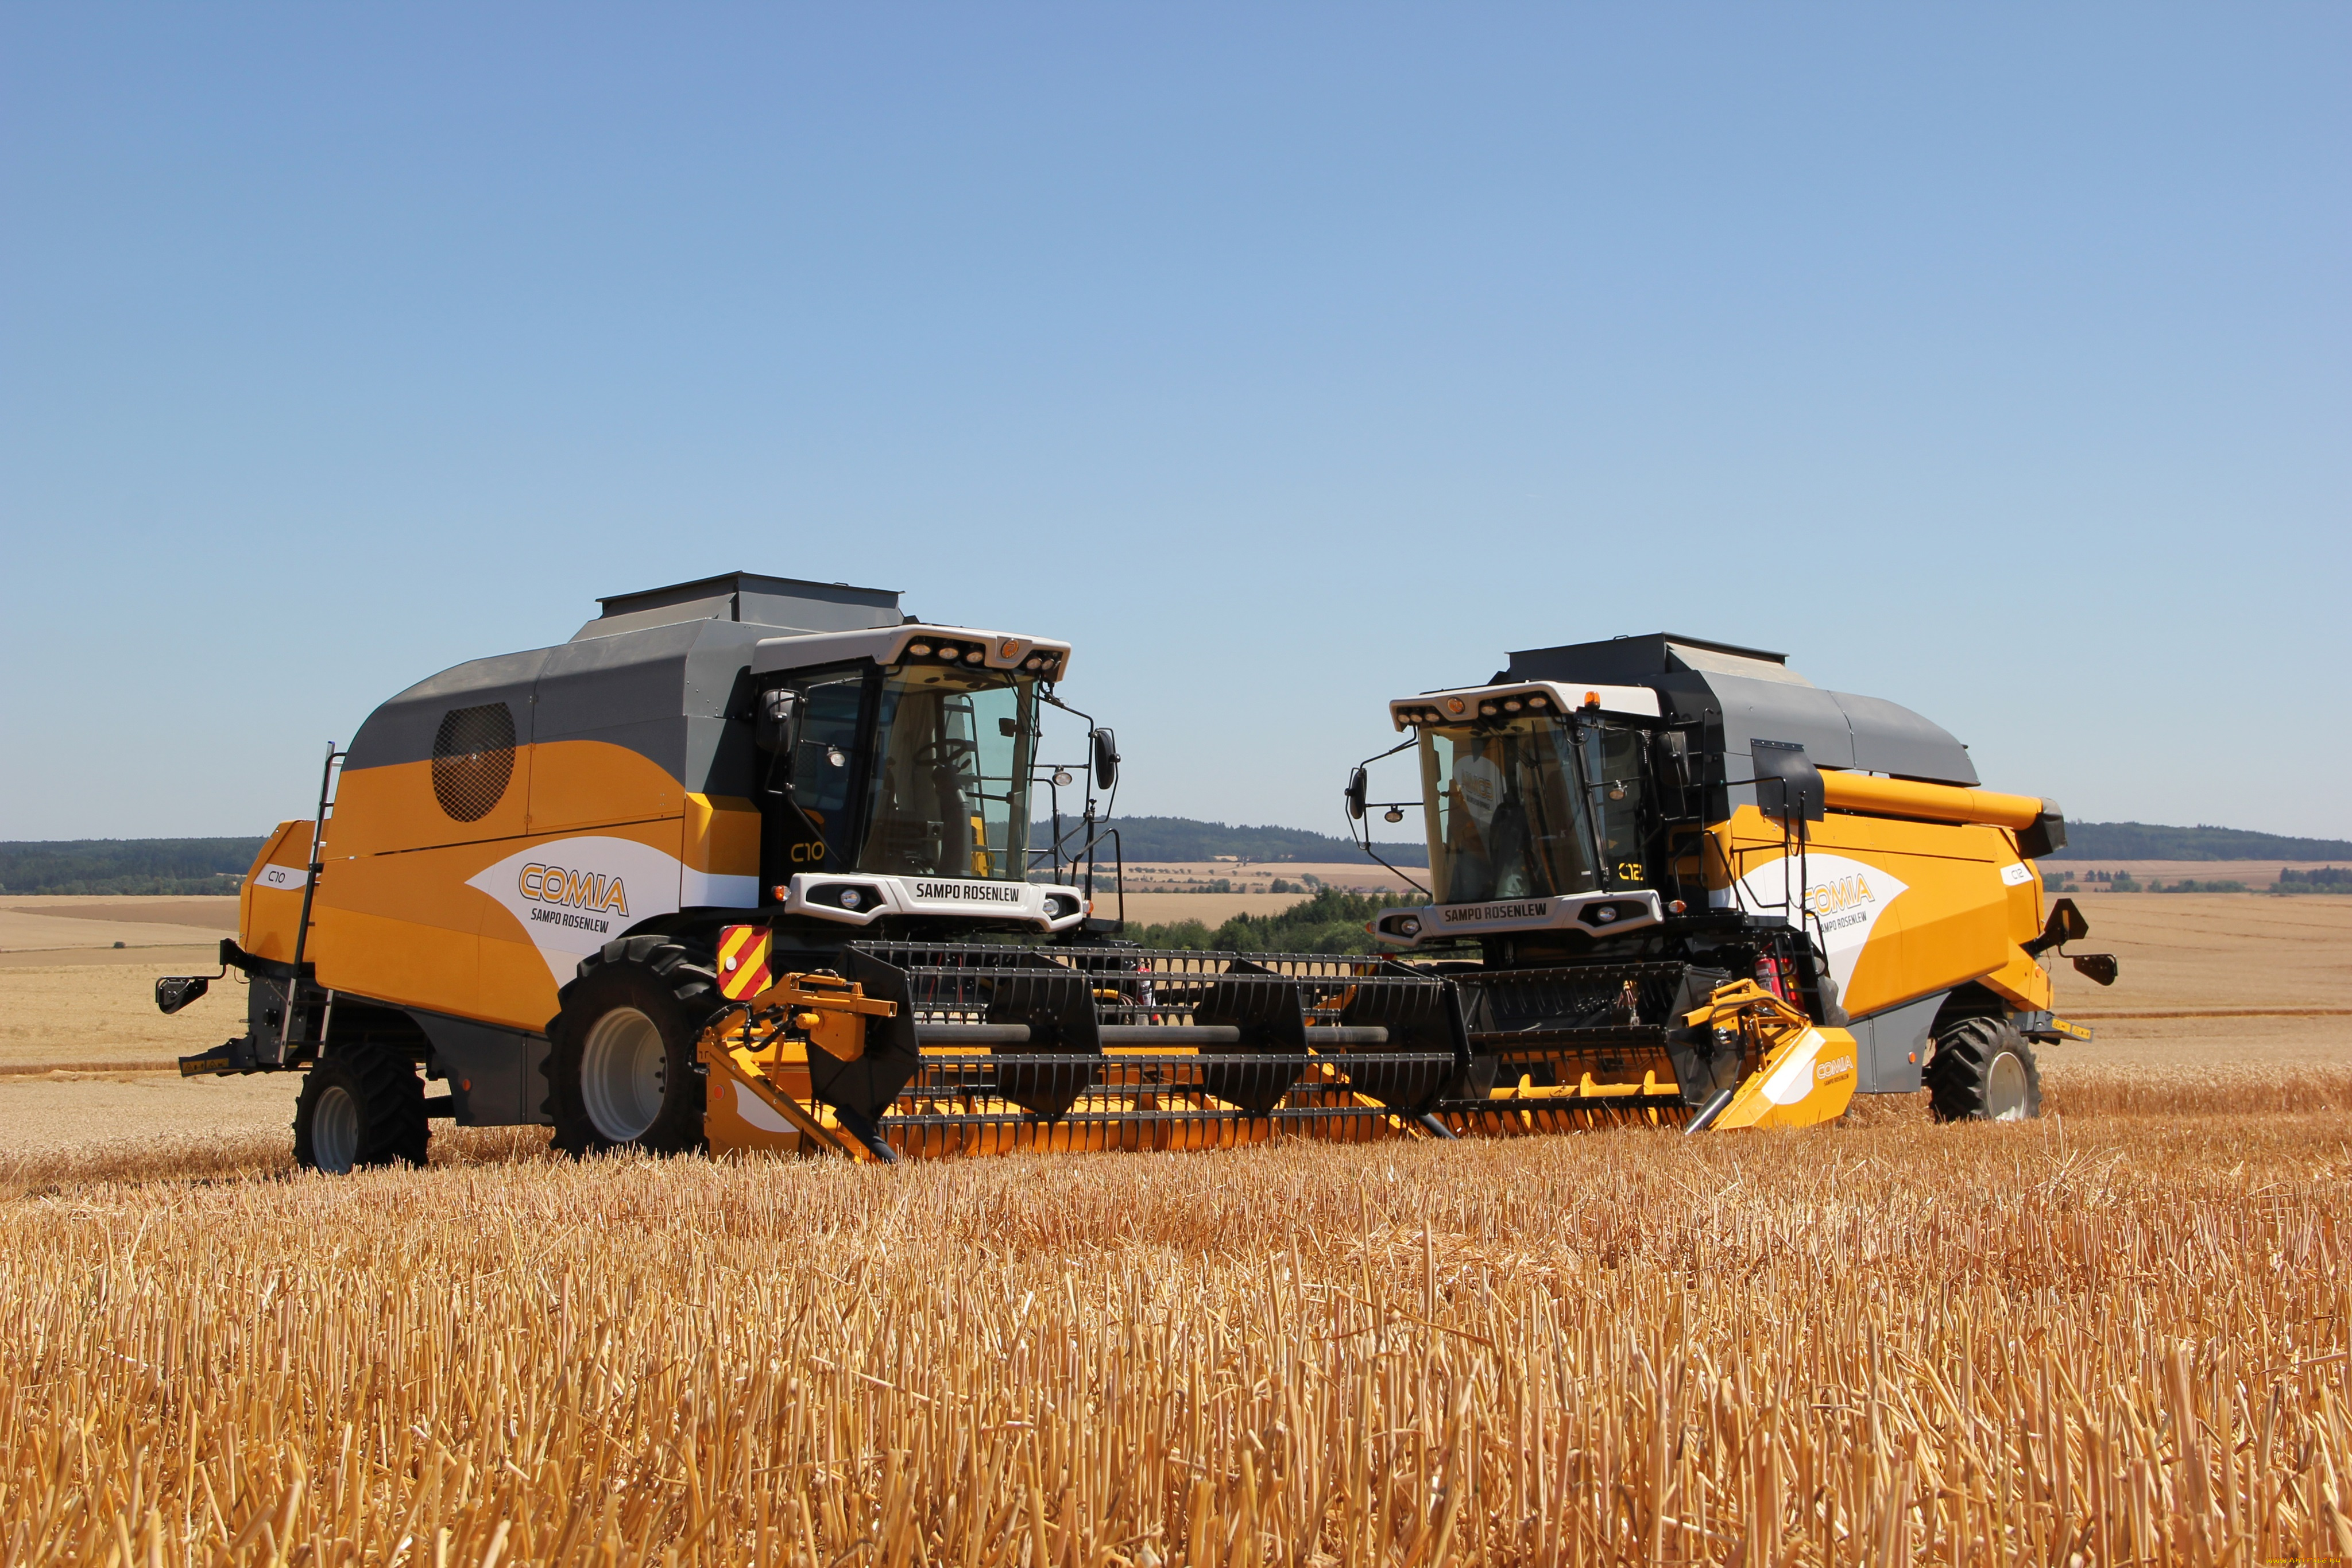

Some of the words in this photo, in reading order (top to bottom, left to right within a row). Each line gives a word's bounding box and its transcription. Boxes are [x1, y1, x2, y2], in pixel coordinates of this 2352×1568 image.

[791, 841, 825, 862] C10
[268, 870, 285, 883] C10
[2011, 868, 2024, 880] C12
[519, 862, 629, 917] COMIA
[916, 883, 960, 899] SAMPO
[964, 885, 1019, 903] ROSENLEW
[531, 908, 561, 925] SAMPO
[562, 913, 609, 934] ROSENLEW
[1445, 907, 1482, 922] SAMPO
[1484, 903, 1546, 919] ROSENLEW
[1820, 920, 1837, 934] AMPO
[1837, 911, 1867, 930] ROSENLEW
[1816, 1054, 1854, 1080] COMIA
